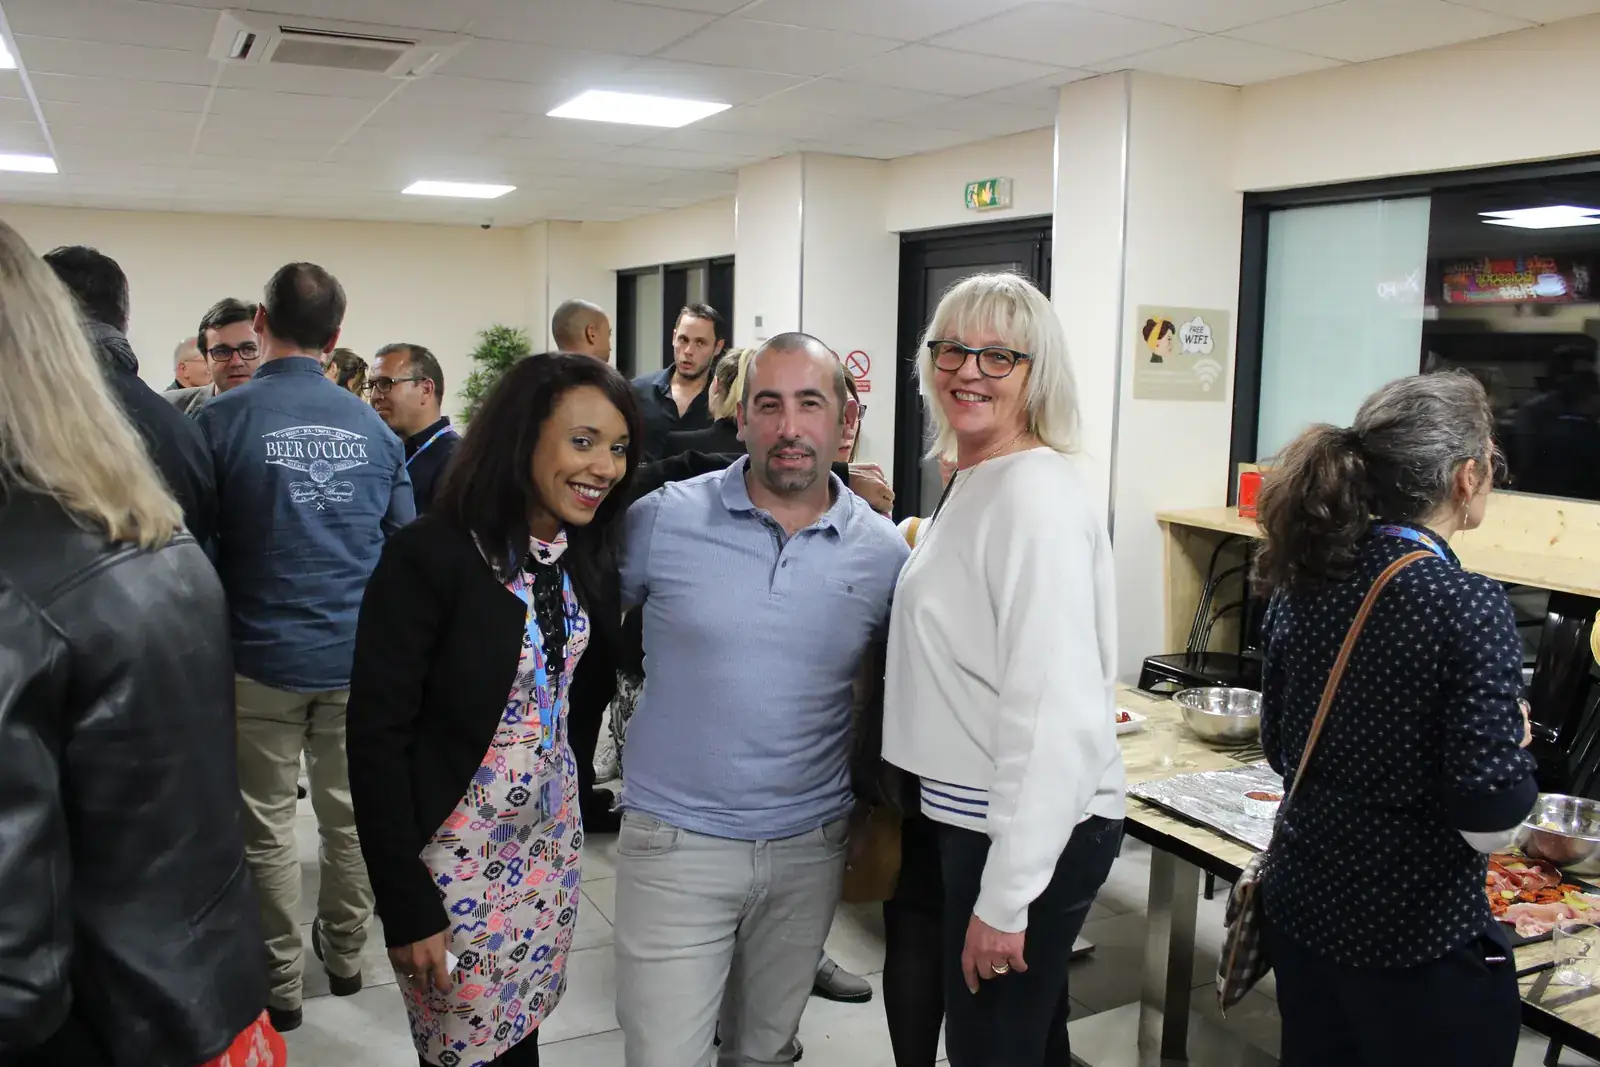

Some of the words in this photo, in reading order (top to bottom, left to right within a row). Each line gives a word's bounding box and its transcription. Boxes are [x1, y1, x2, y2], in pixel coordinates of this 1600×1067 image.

[1189, 326, 1204, 334] FREE
[1185, 335, 1209, 344] WIFI
[266, 441, 304, 458] BEER
[307, 440, 368, 459] O'CLOCK
